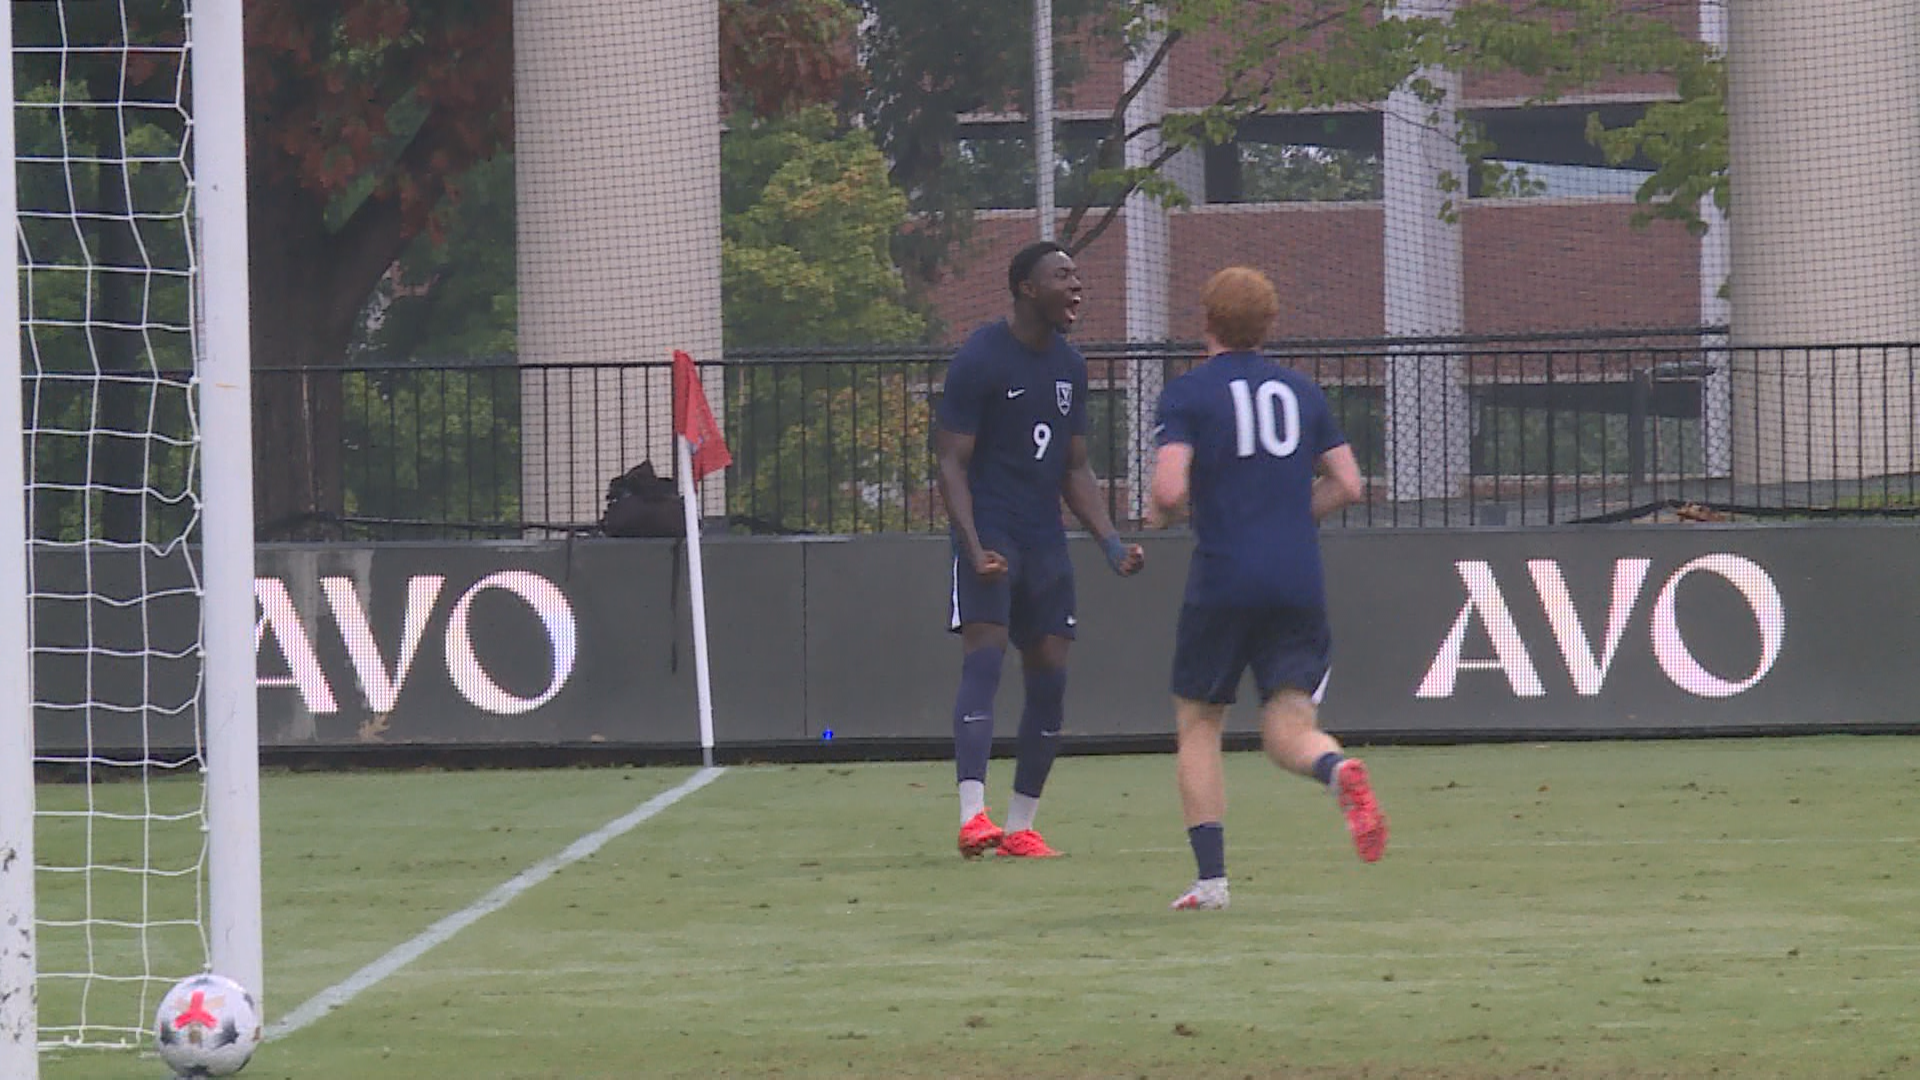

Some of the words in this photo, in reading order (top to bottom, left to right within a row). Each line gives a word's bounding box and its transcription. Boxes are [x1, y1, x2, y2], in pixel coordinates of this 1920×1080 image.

[1033, 422, 1052, 461] 9
[1229, 379, 1300, 457] 10
[255, 570, 577, 715] AVO
[1415, 552, 1785, 698] AVO
